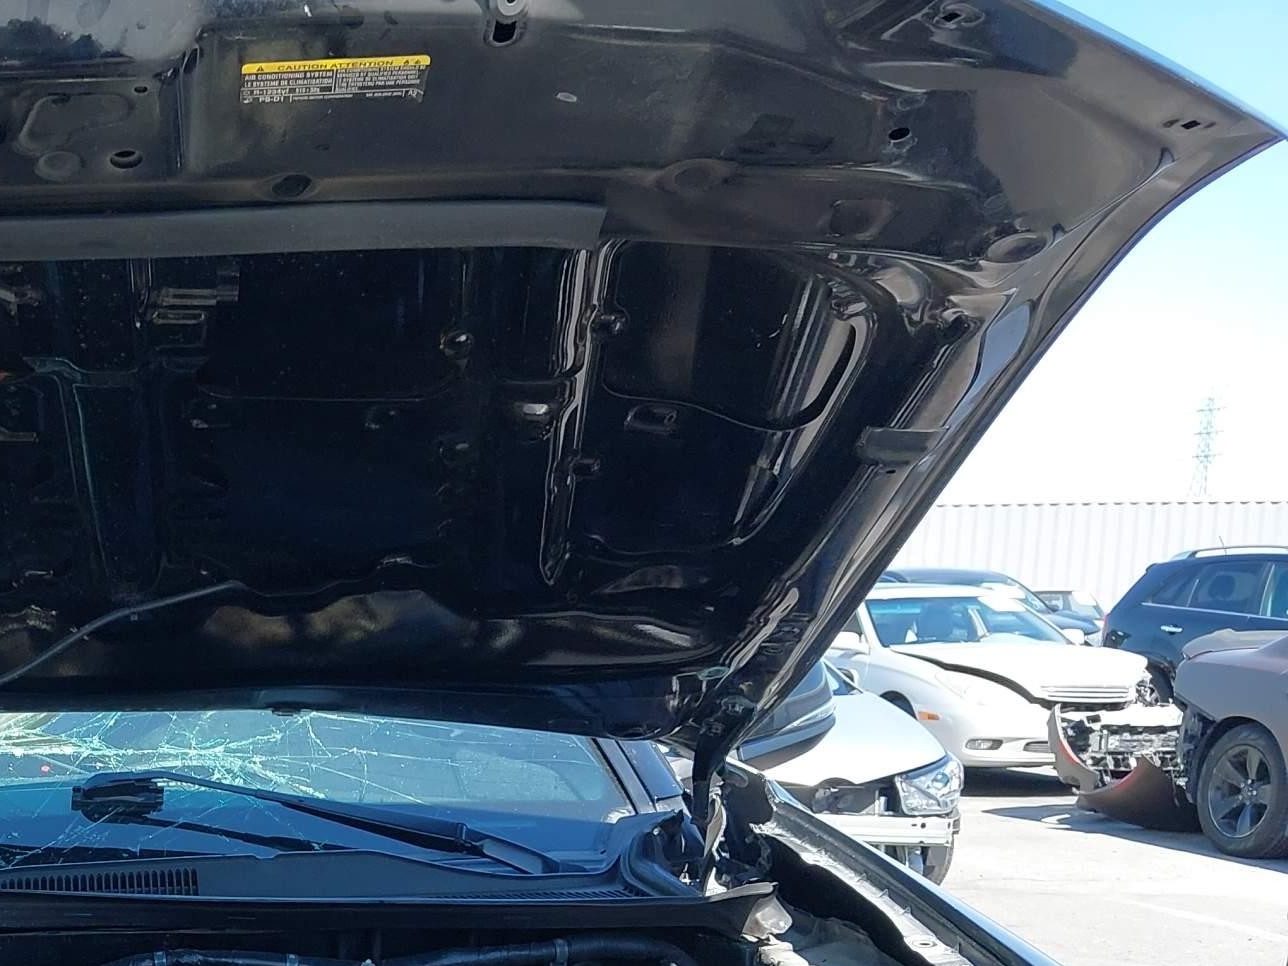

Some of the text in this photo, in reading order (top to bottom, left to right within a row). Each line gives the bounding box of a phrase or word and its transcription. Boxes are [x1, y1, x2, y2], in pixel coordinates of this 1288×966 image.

[277, 63, 327, 71] CAUTION
[329, 60, 393, 68] ATTENTION
[258, 72, 305, 80] CONDITIONING
[305, 71, 333, 79] SYSTEM
[289, 78, 333, 86] CLIMATISATION
